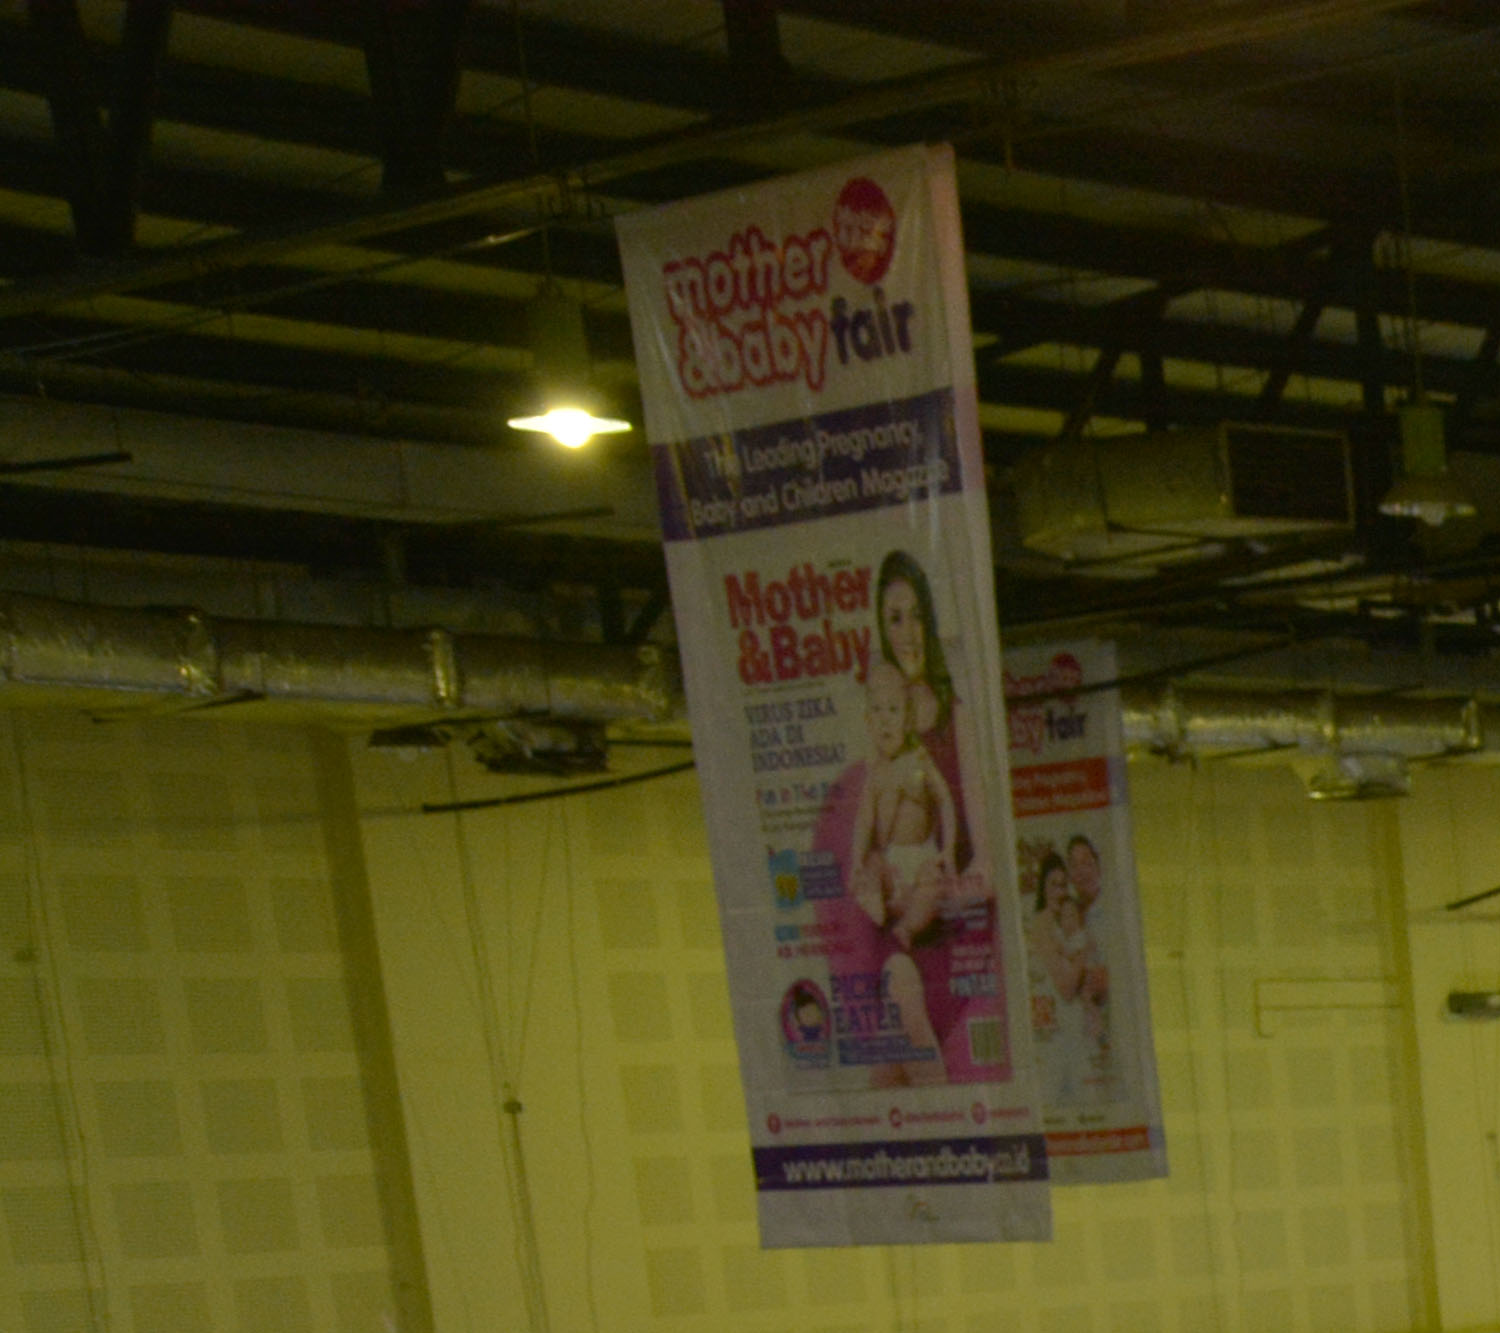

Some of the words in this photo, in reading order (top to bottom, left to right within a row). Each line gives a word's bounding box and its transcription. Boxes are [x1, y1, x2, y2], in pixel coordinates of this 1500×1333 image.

[663, 226, 832, 325] mother
[676, 305, 830, 398] &baby
[830, 286, 914, 365] fair
[742, 433, 817, 475] Leading
[690, 497, 738, 528] Baby
[741, 487, 780, 517] and
[782, 473, 858, 514] Children
[861, 458, 950, 502] Magazine
[724, 563, 871, 629] Mother
[737, 619, 871, 685] &Baby
